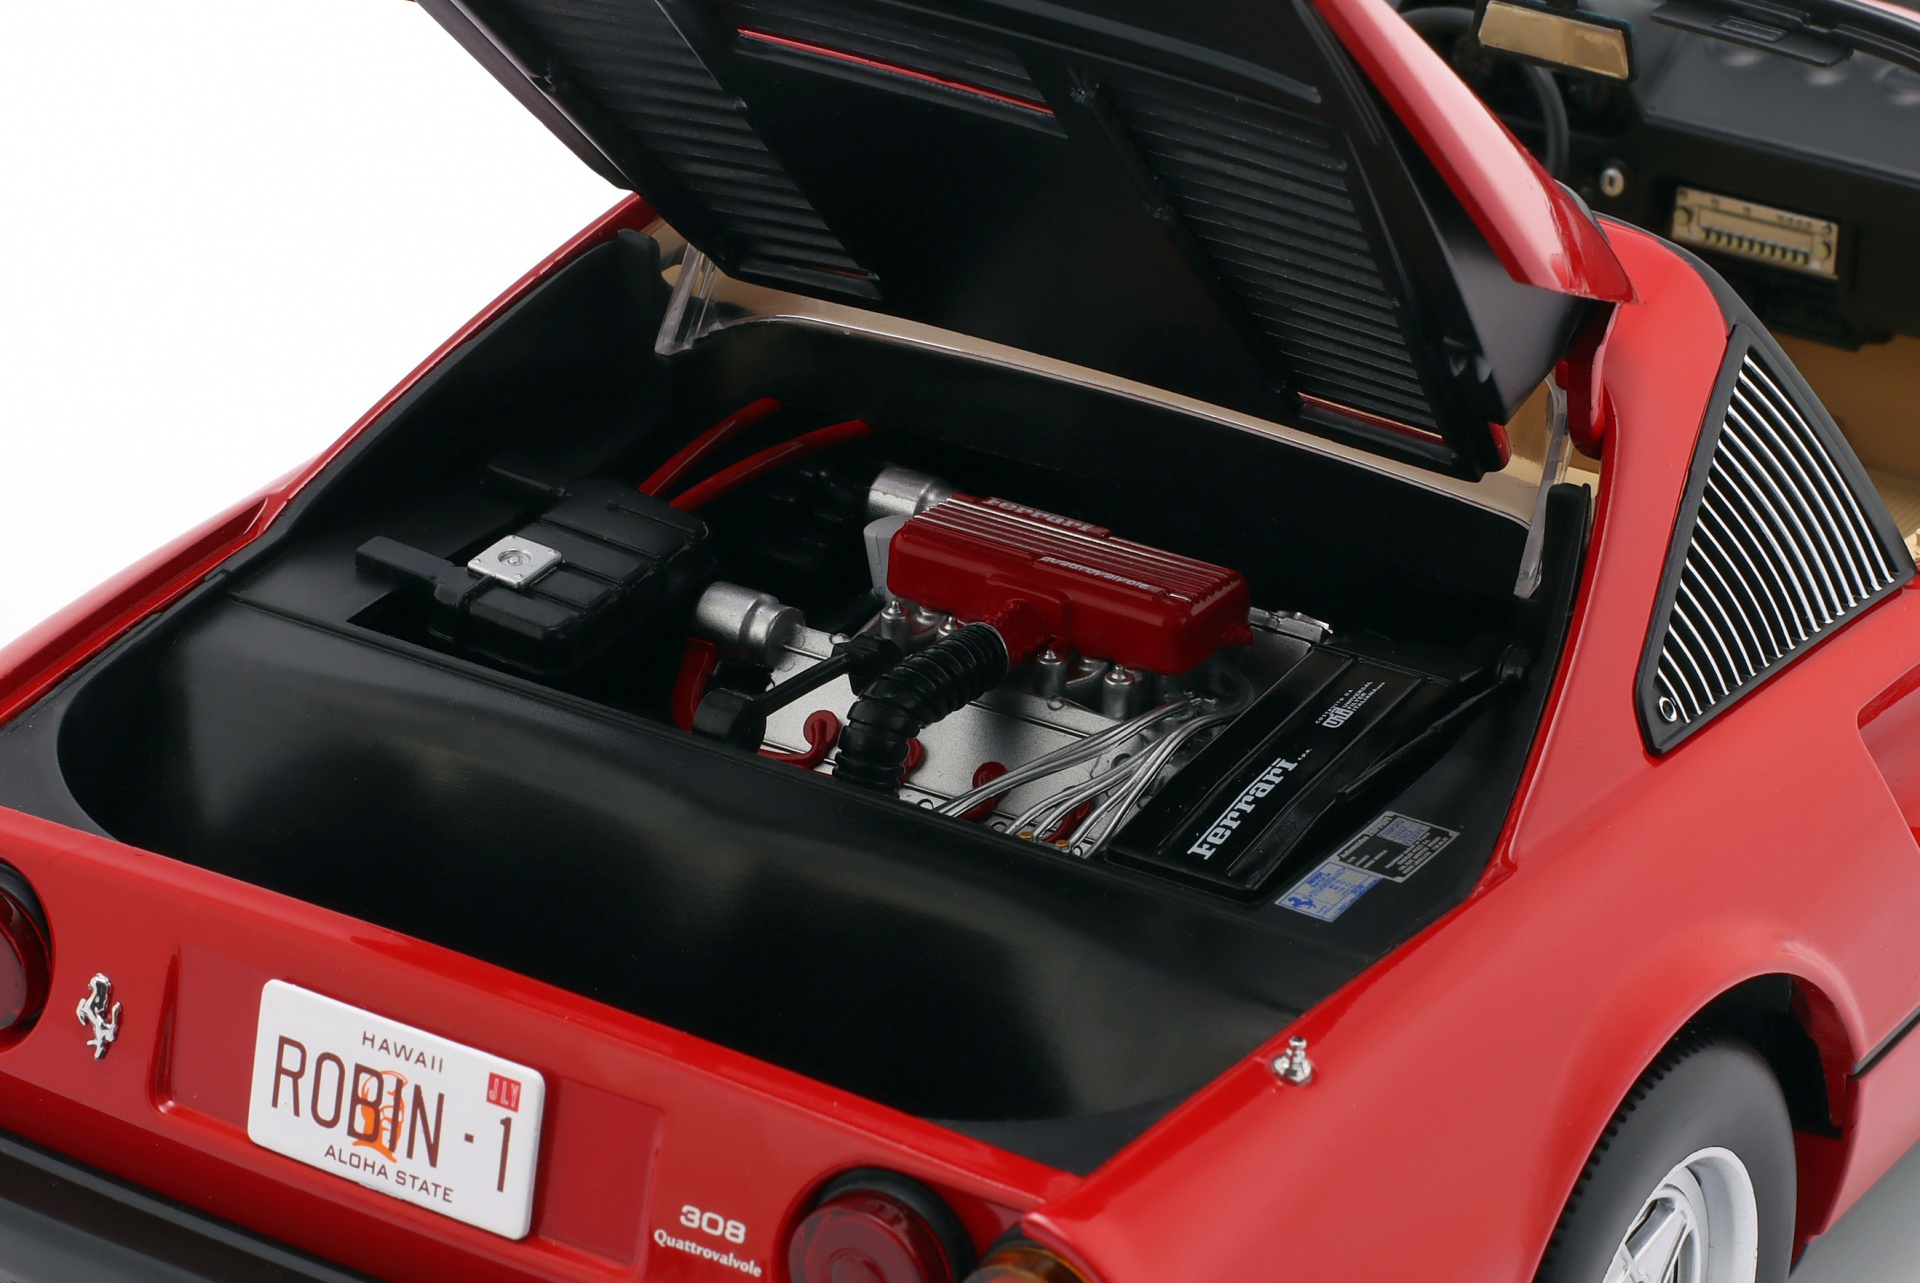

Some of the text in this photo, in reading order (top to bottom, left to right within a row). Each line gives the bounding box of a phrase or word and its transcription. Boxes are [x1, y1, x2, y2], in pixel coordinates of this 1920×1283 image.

[983, 496, 1096, 532] Ferrari
[1187, 757, 1299, 861] Ferrari
[362, 1031, 444, 1073] HAWAII
[271, 1034, 445, 1169] ROBIN
[496, 1116, 512, 1193] 1
[488, 1077, 520, 1108] JLY
[324, 1144, 455, 1204] ALOHA STATE
[679, 1204, 746, 1244] 308
[653, 1229, 762, 1278] Quattrovalvole
